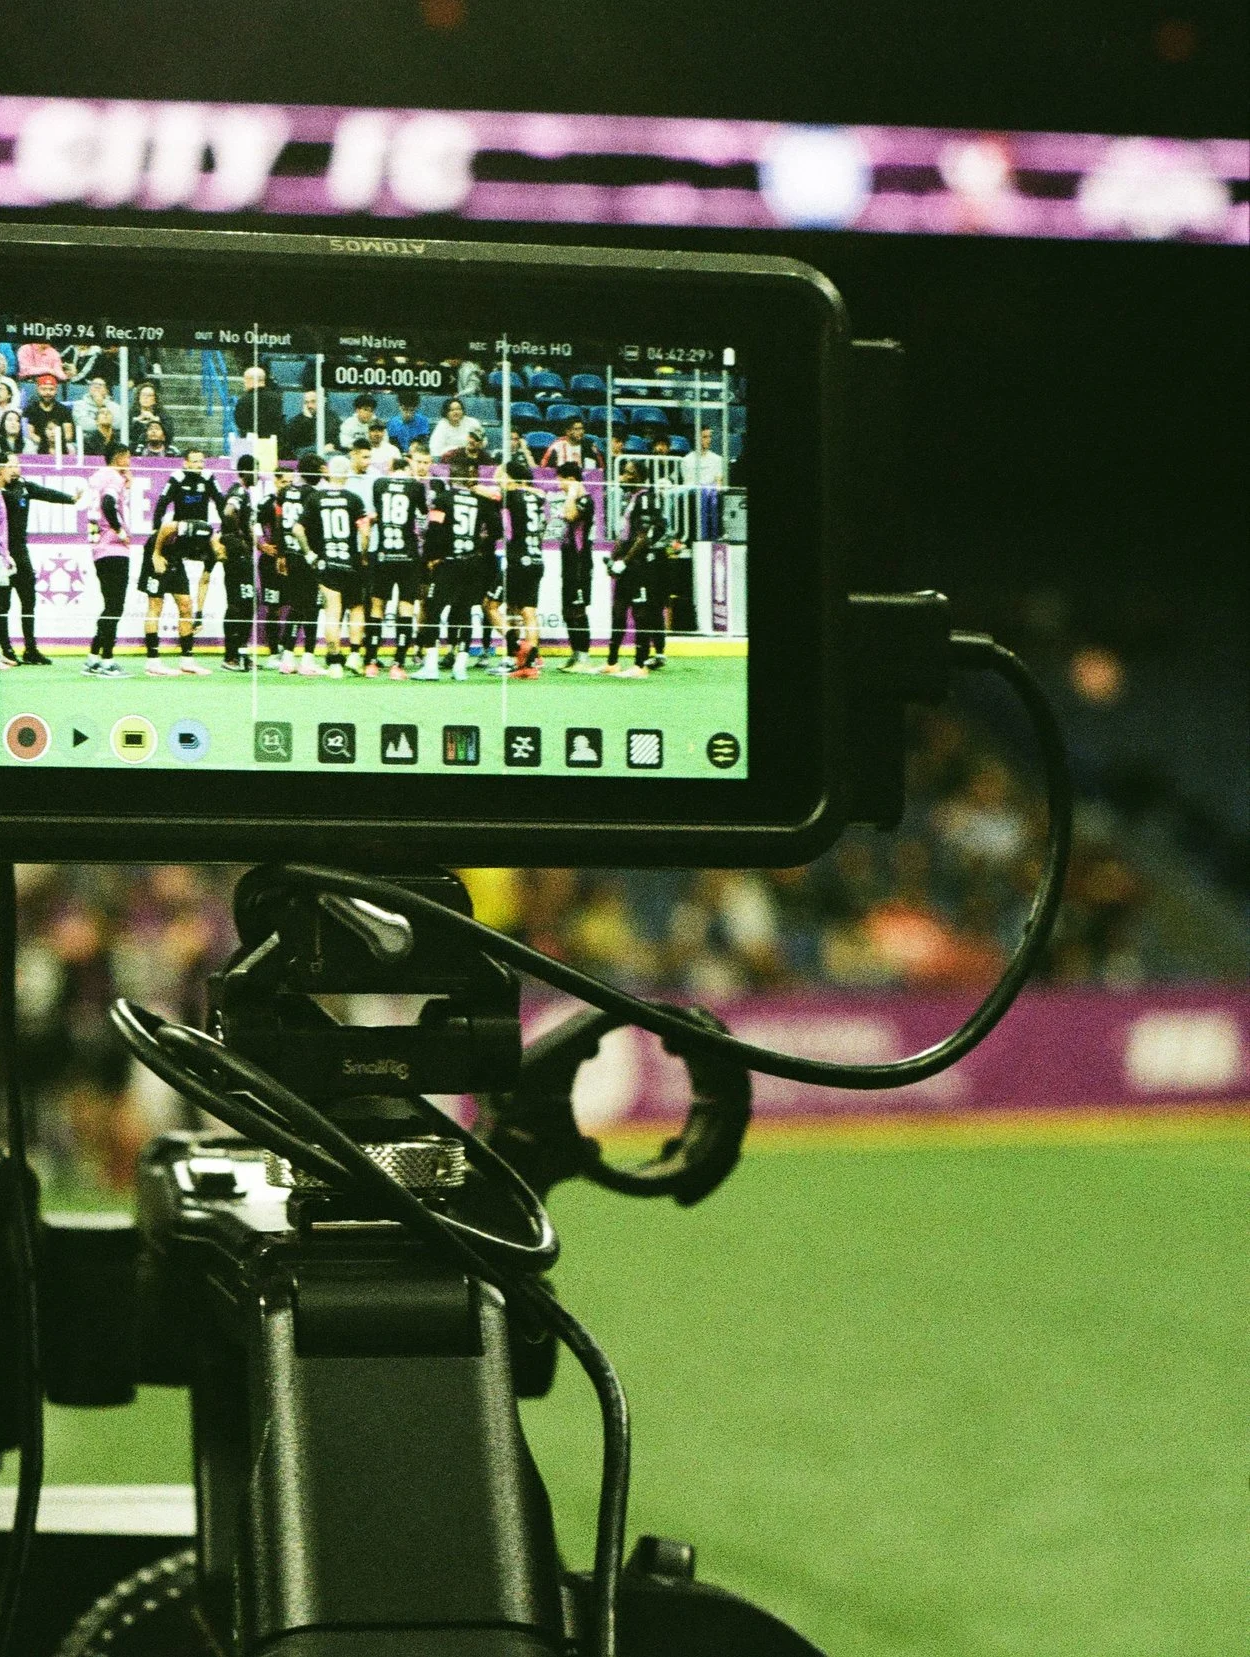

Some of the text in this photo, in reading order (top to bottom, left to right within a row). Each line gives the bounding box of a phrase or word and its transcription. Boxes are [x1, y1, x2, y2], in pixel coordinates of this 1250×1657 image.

[330, 239, 426, 254] ATOMOS
[22, 322, 95, 340] HDp59.94
[105, 325, 164, 340] Rec.709
[219, 329, 240, 343] No
[244, 331, 291, 348] Output
[362, 335, 407, 349] Native
[495, 341, 547, 356] ProRes
[550, 343, 572, 356] HQ
[335, 367, 441, 388] 00:00:00:00
[320, 508, 350, 540] 10
[381, 493, 410, 525] 18
[453, 505, 478, 536] 51
